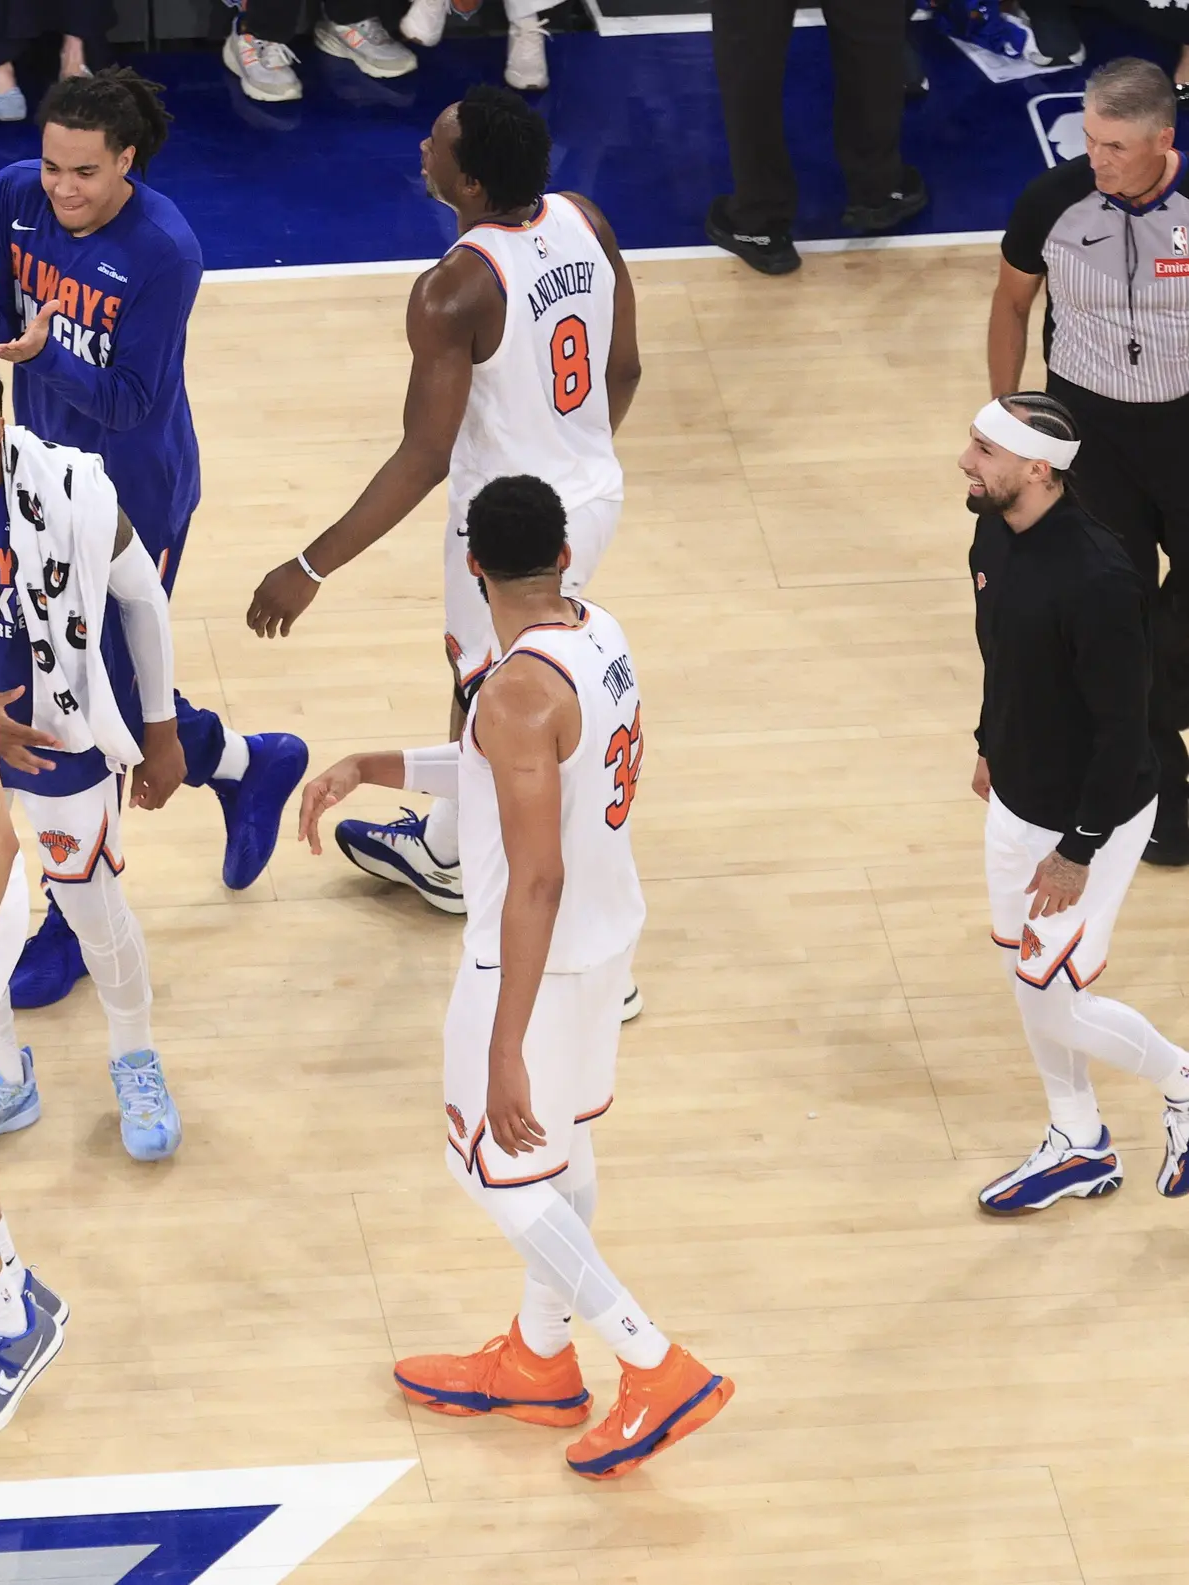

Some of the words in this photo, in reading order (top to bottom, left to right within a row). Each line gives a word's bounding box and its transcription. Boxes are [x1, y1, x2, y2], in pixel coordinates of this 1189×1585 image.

[528, 261, 595, 322] ANUNOBY
[1155, 261, 1189, 273] Emira
[550, 314, 592, 416] 8
[603, 654, 635, 706] TOWNS
[604, 700, 644, 831] 32
